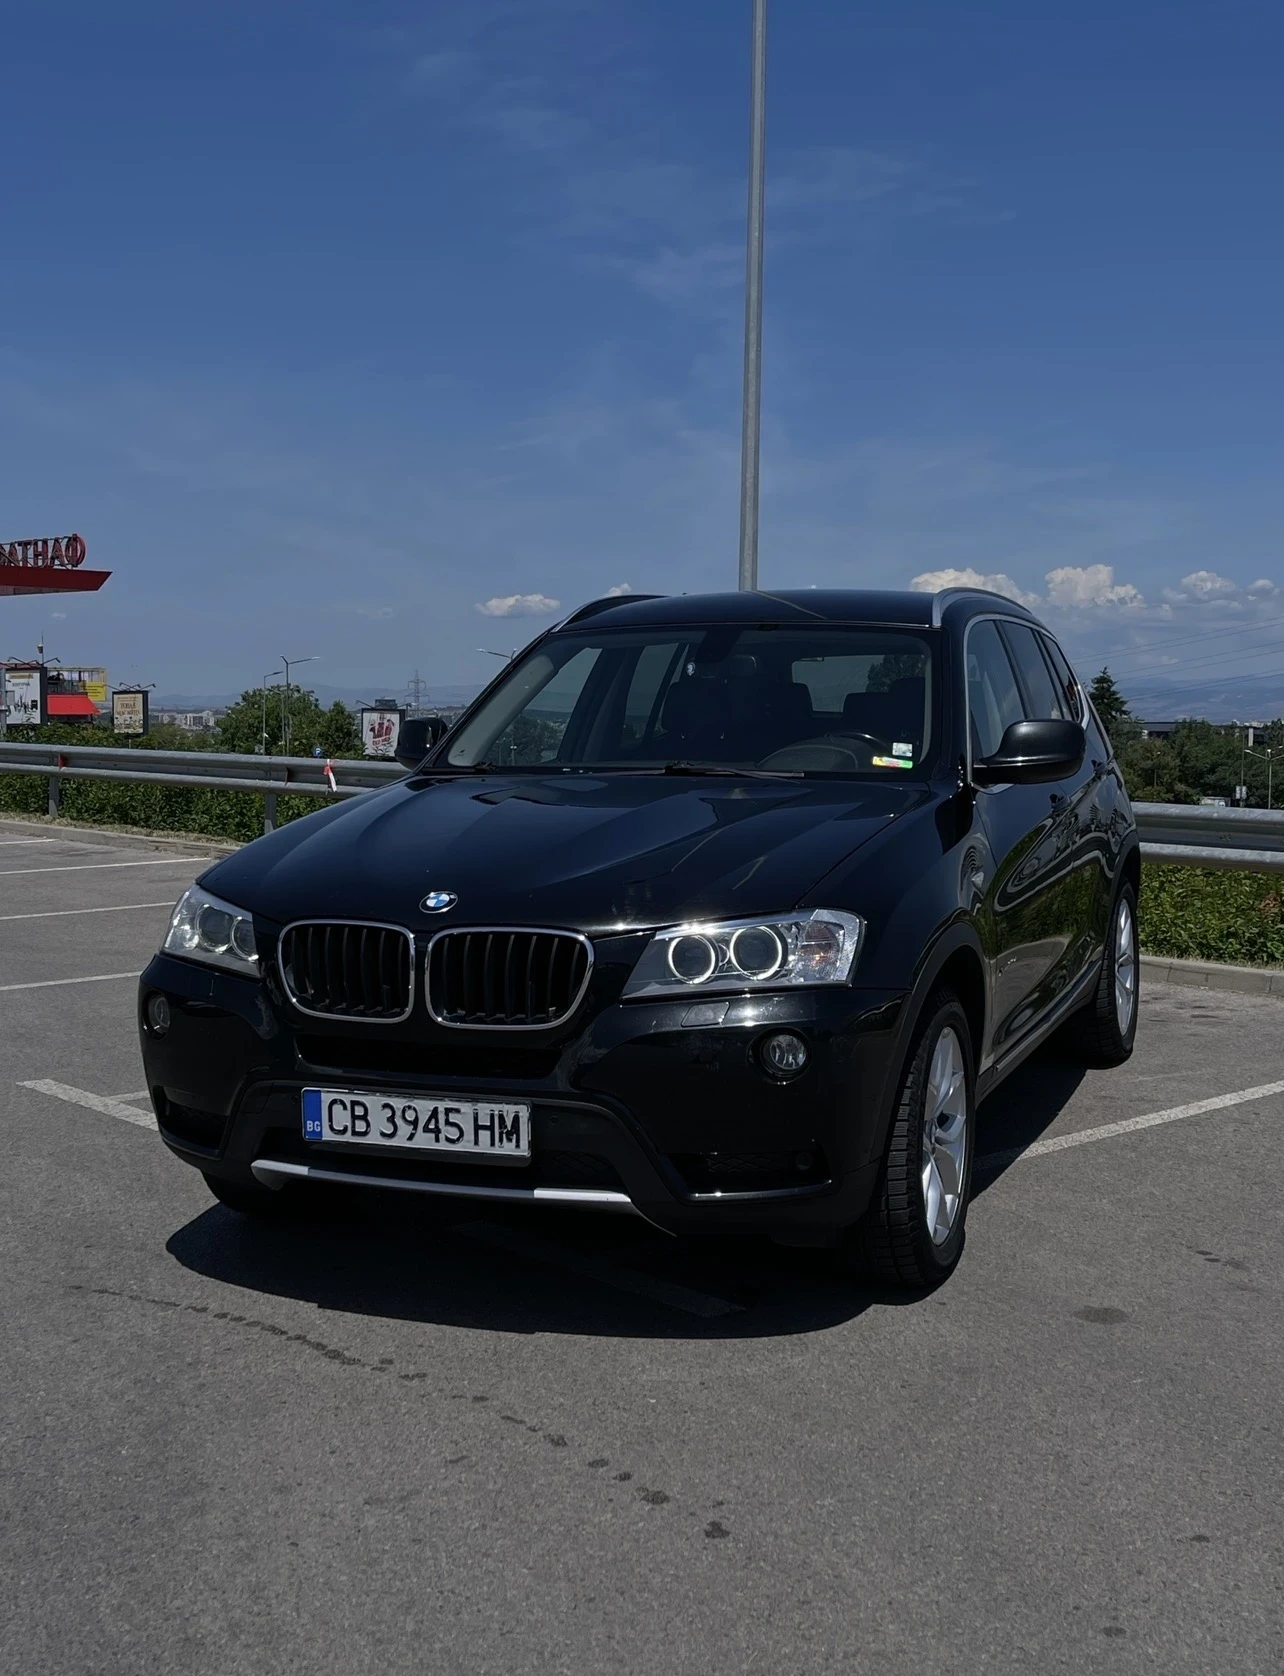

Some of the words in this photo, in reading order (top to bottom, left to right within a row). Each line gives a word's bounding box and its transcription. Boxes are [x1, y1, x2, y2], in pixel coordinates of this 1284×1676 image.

[306, 1120, 321, 1132] BG
[327, 1098, 371, 1137] CB
[379, 1102, 465, 1144] 3945
[473, 1108, 521, 1149] HM
